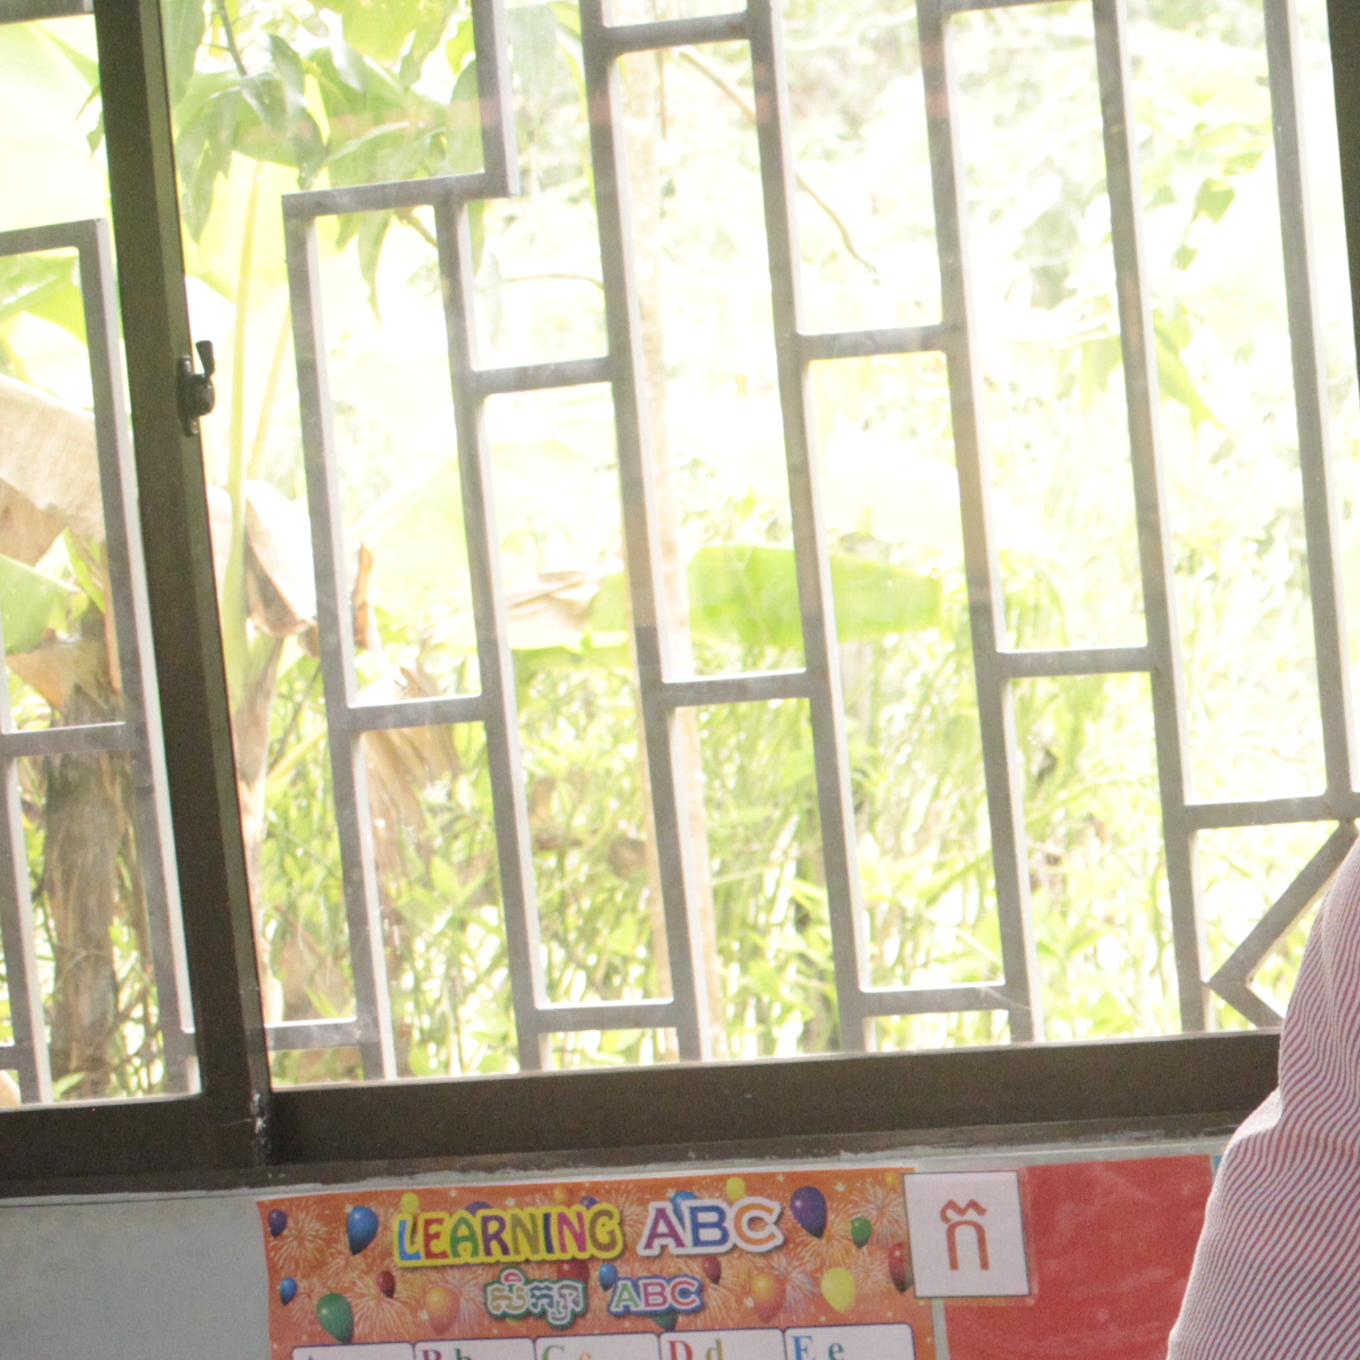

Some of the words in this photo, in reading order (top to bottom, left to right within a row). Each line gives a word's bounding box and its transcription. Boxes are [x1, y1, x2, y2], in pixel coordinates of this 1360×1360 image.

[394, 1203, 623, 1268] LEARNING
[637, 1196, 785, 1257] ABC
[940, 1198, 990, 1271] ក
[609, 1273, 704, 1316] ABC
